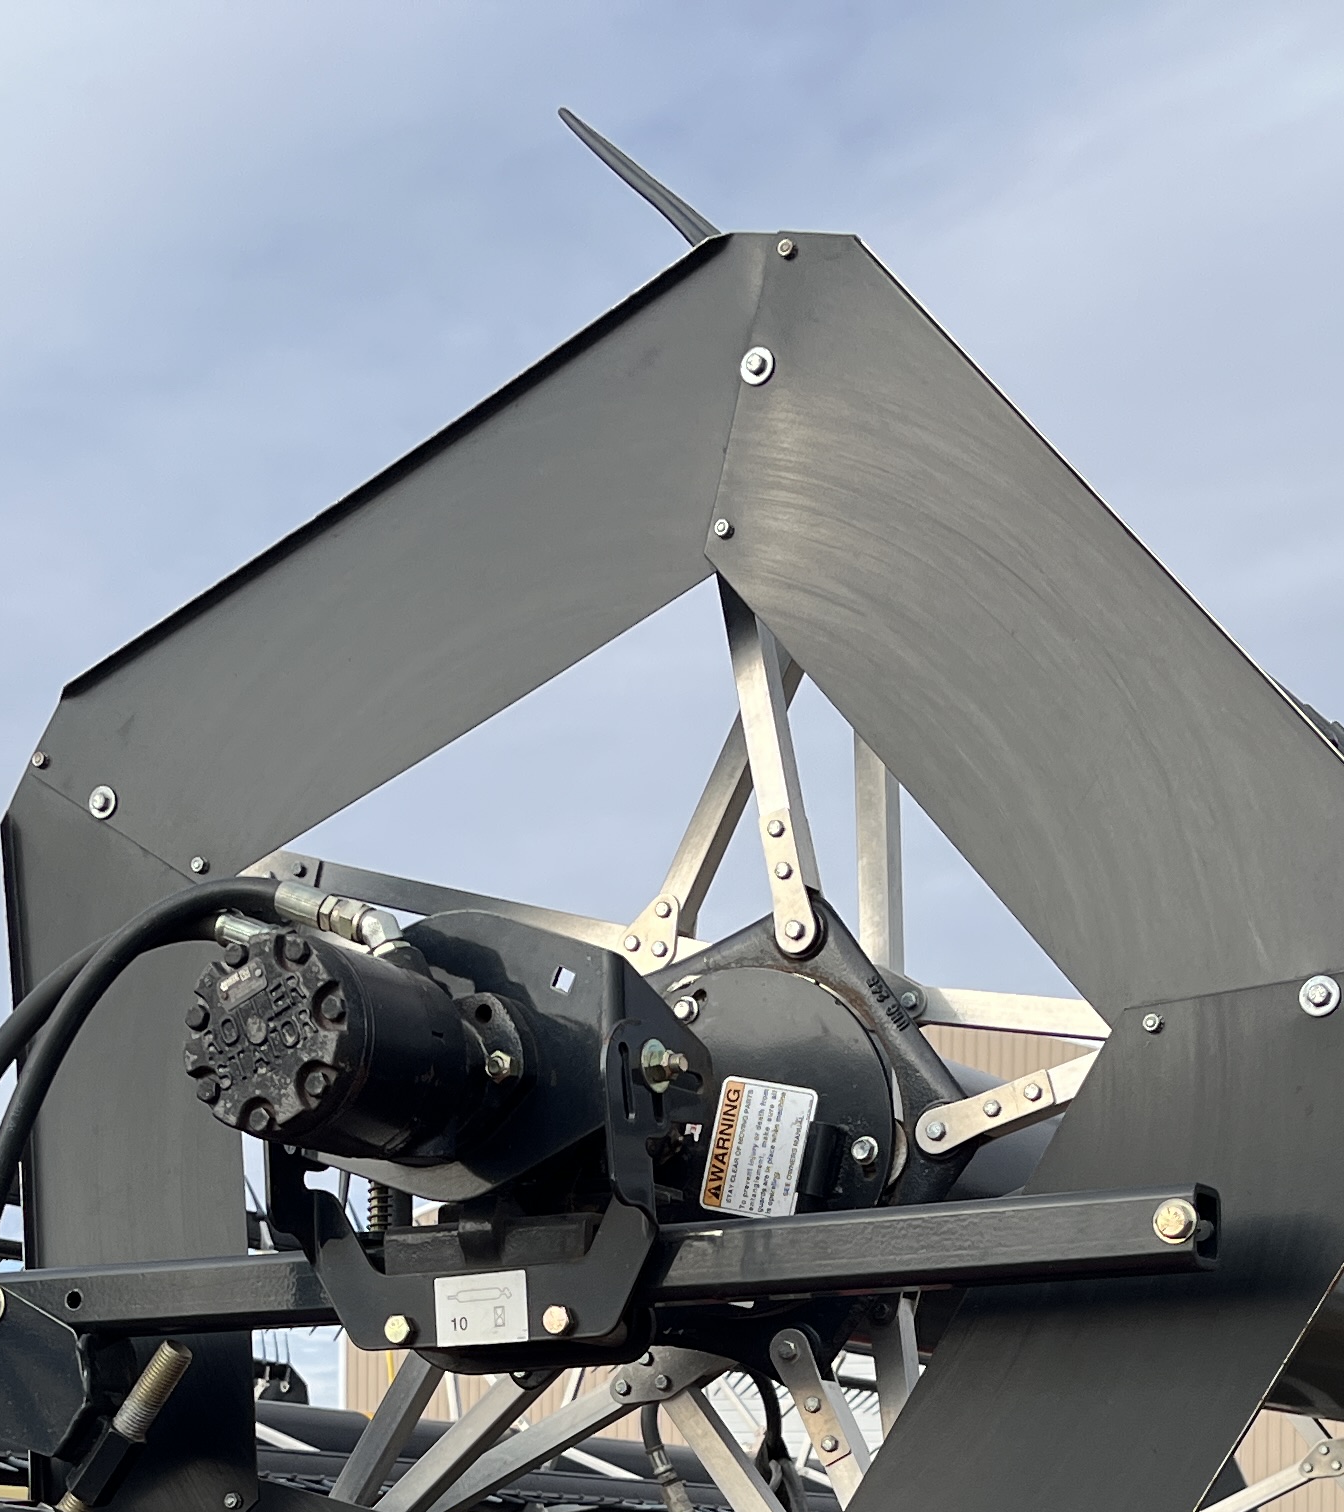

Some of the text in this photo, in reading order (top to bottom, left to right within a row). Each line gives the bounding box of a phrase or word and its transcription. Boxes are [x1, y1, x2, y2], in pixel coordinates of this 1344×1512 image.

[215, 1008, 319, 1091] STATOR
[760, 1089, 769, 1106] from
[707, 1089, 741, 1187] WARNING
[756, 1109, 765, 1130] death
[762, 1127, 770, 1148] make
[767, 1104, 775, 1122] sure
[726, 1184, 734, 1203] STAY
[730, 1158, 739, 1182] CLEAR
[735, 1146, 741, 1156] OF
[744, 1089, 754, 1114] PARTS
[743, 1168, 753, 1198] prevent
[758, 1188, 767, 1212] guards
[767, 1144, 775, 1165] place
[739, 1200, 746, 1209] To
[451, 1317, 468, 1331] 10
